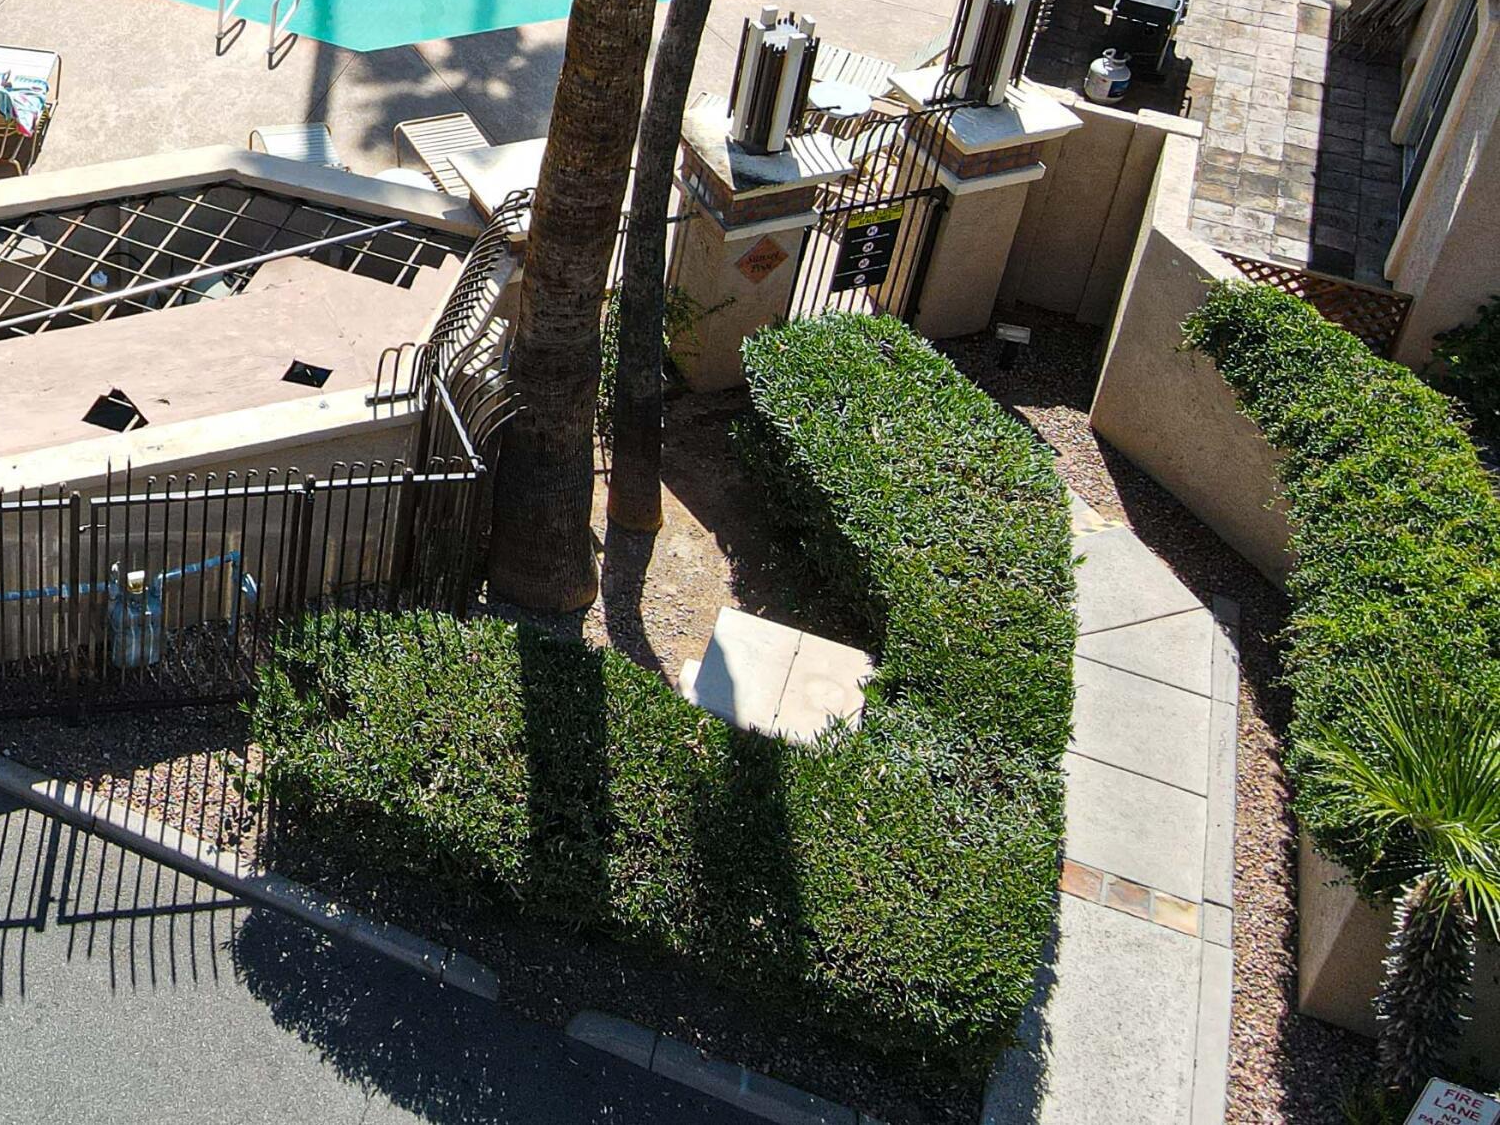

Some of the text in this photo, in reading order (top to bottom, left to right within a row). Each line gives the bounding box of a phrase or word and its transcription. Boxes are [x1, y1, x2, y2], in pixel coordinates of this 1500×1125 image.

[1443, 1088, 1485, 1109] FIRE
[1433, 1097, 1481, 1122] LANE
[1441, 1113, 1462, 1125] NO
